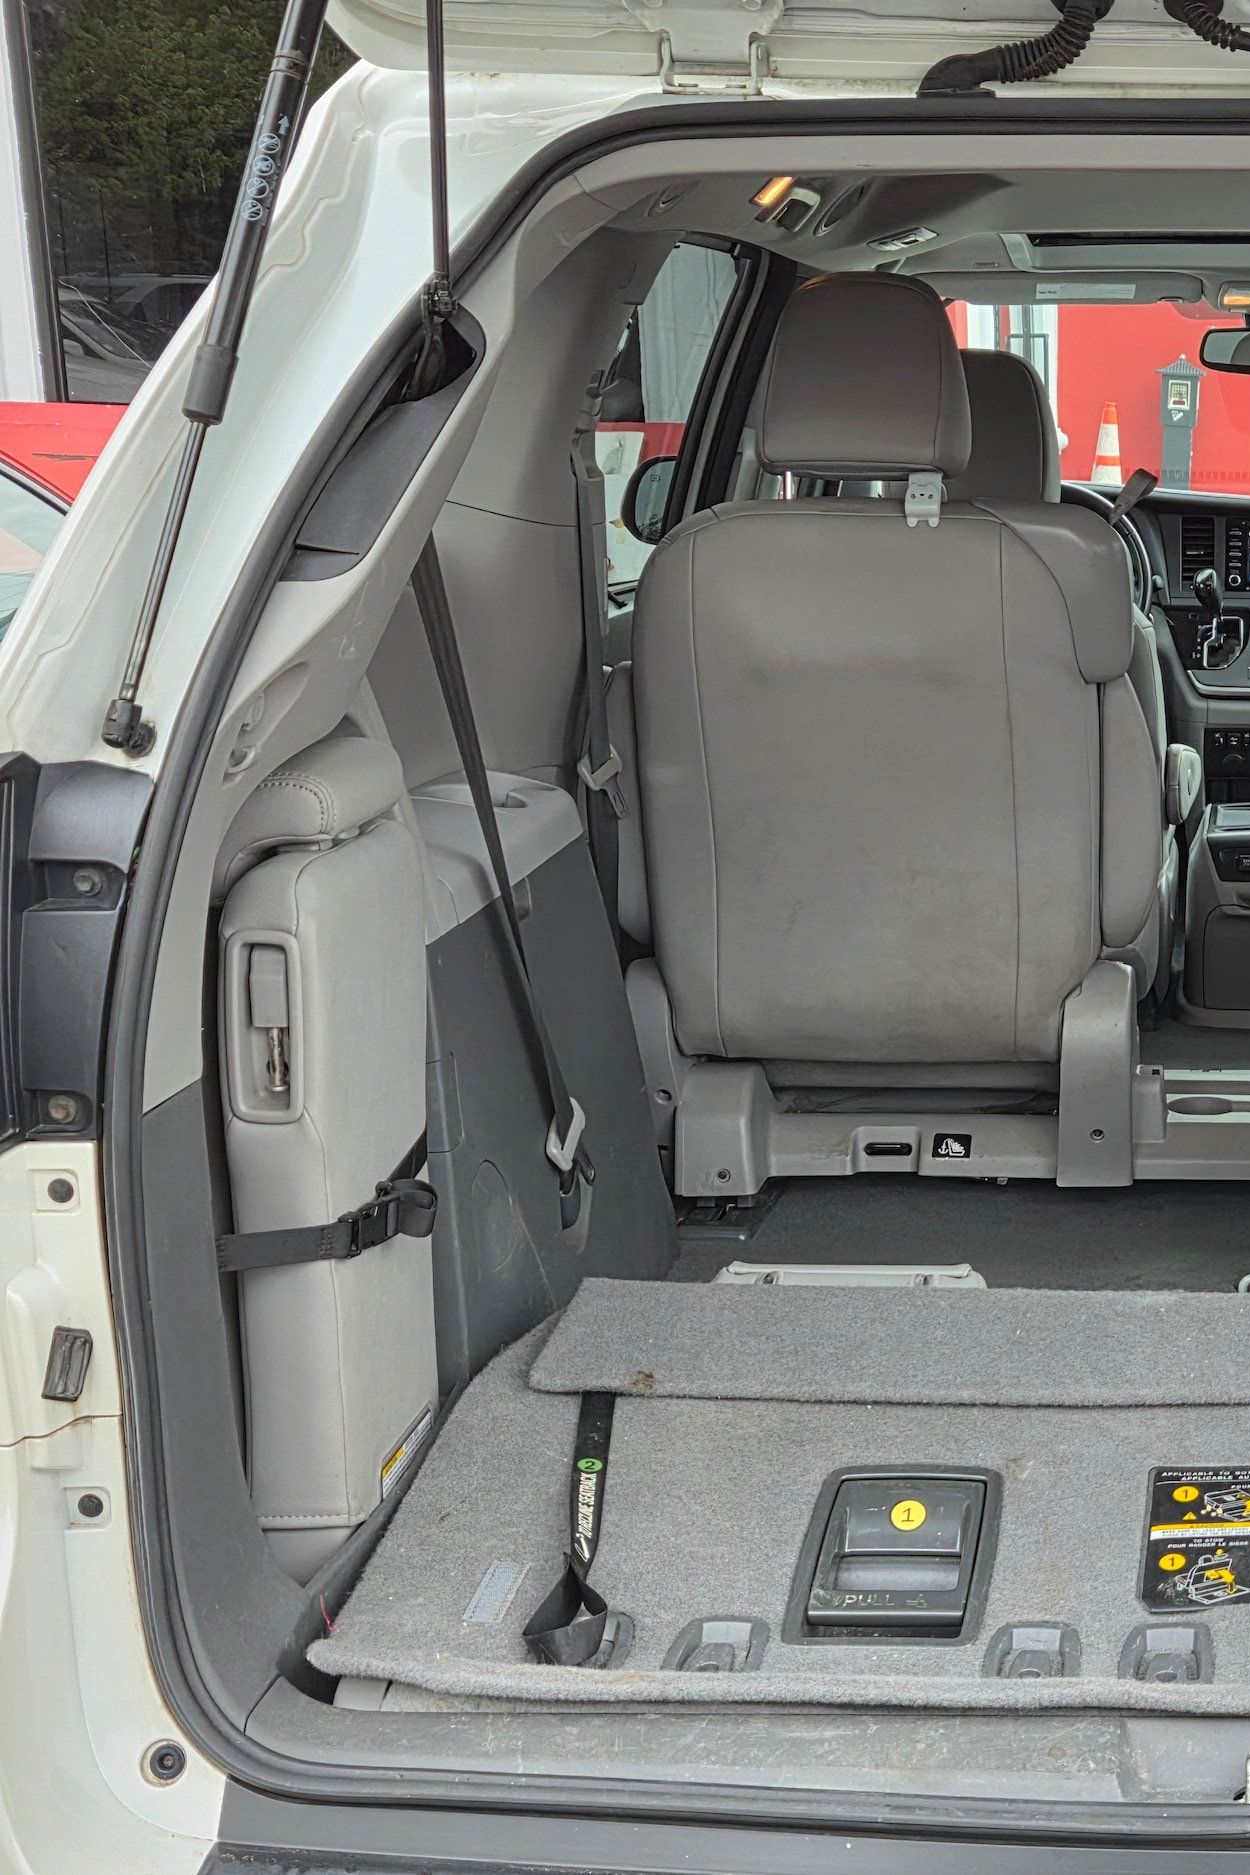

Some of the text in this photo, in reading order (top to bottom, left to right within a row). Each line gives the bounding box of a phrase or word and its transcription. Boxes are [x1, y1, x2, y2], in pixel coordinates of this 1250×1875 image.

[584, 1460, 596, 1470] 2
[1182, 1489, 1189, 1499] 1
[901, 1507, 915, 1523] 1
[1168, 1557, 1175, 1567] 1
[843, 1594, 895, 1607] PULL
